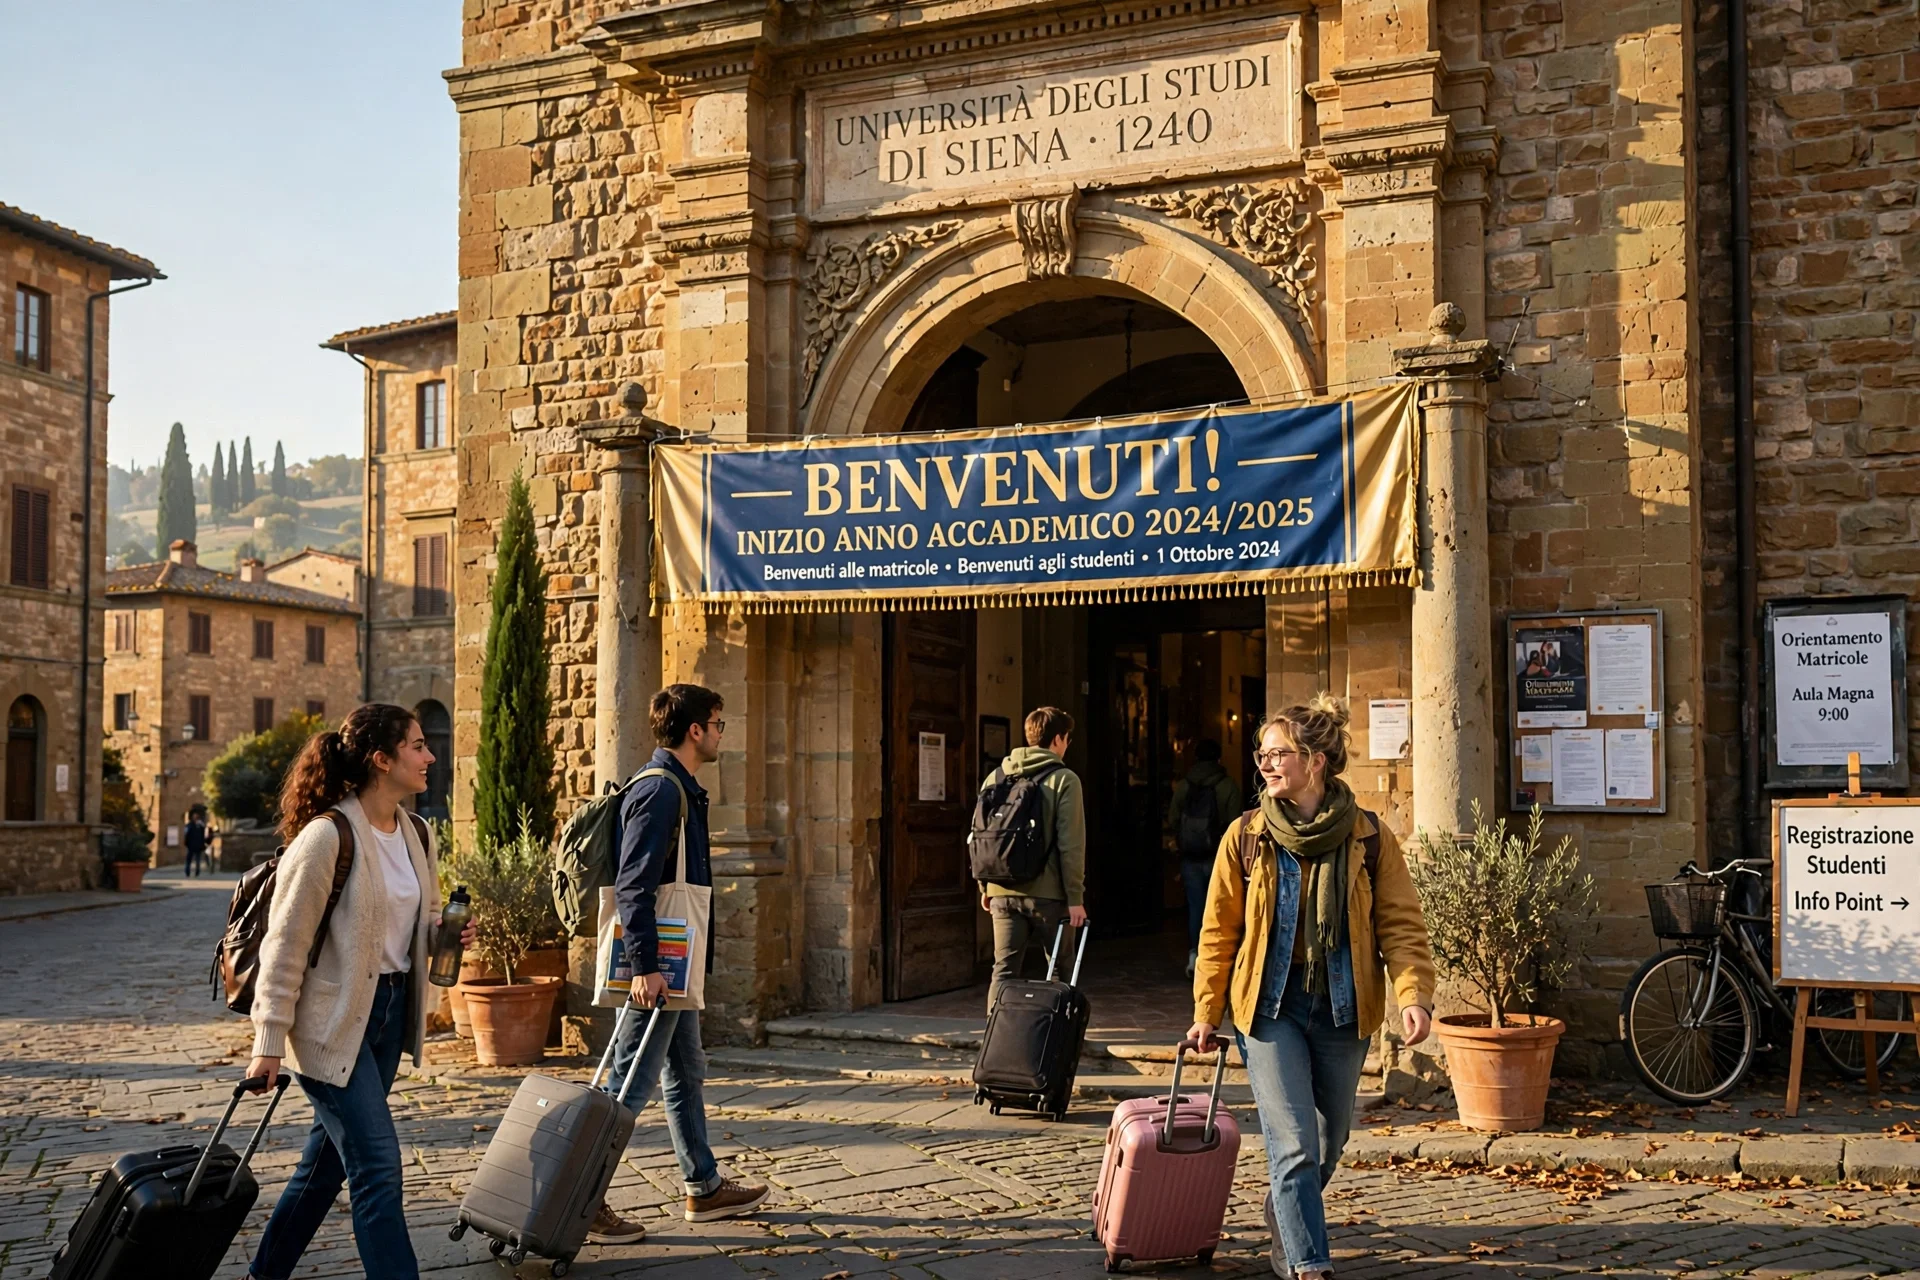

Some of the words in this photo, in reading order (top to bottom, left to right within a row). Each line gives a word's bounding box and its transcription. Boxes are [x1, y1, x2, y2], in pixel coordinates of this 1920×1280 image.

[836, 85, 1033, 147] UNIVERSITÀ
[1048, 73, 1150, 118] DEGLI
[1165, 55, 1271, 100] STUDI
[888, 146, 928, 183] DI
[946, 127, 1072, 176] SIENA
[1116, 108, 1213, 153] 1240
[804, 428, 1220, 516] BENVENUTI!
[737, 527, 825, 555] INIZIO
[833, 523, 918, 552] ANNO
[927, 511, 1135, 548] ACCADEMICO
[1145, 497, 1314, 537] 2024/2025
[764, 563, 835, 580] Benvenuti
[839, 562, 865, 579] alle
[869, 560, 938, 577] matricole
[958, 555, 1034, 574] Benvenuti
[1038, 552, 1065, 575] agli
[1070, 549, 1135, 569] studenti
[1157, 548, 1165, 564] 1
[1170, 544, 1233, 563] Ottobre
[1239, 540, 1280, 559] 2024
[1782, 631, 1883, 647] Orientamento
[1797, 651, 1869, 667] Matricole
[1792, 687, 1823, 701] Aula
[1827, 686, 1875, 704] Magna
[1818, 707, 1849, 722] 9:00
[1787, 825, 1914, 849] Registrazione
[1807, 854, 1886, 875] Studenti
[1795, 890, 1830, 910] Info
[1835, 891, 1884, 911] Point
